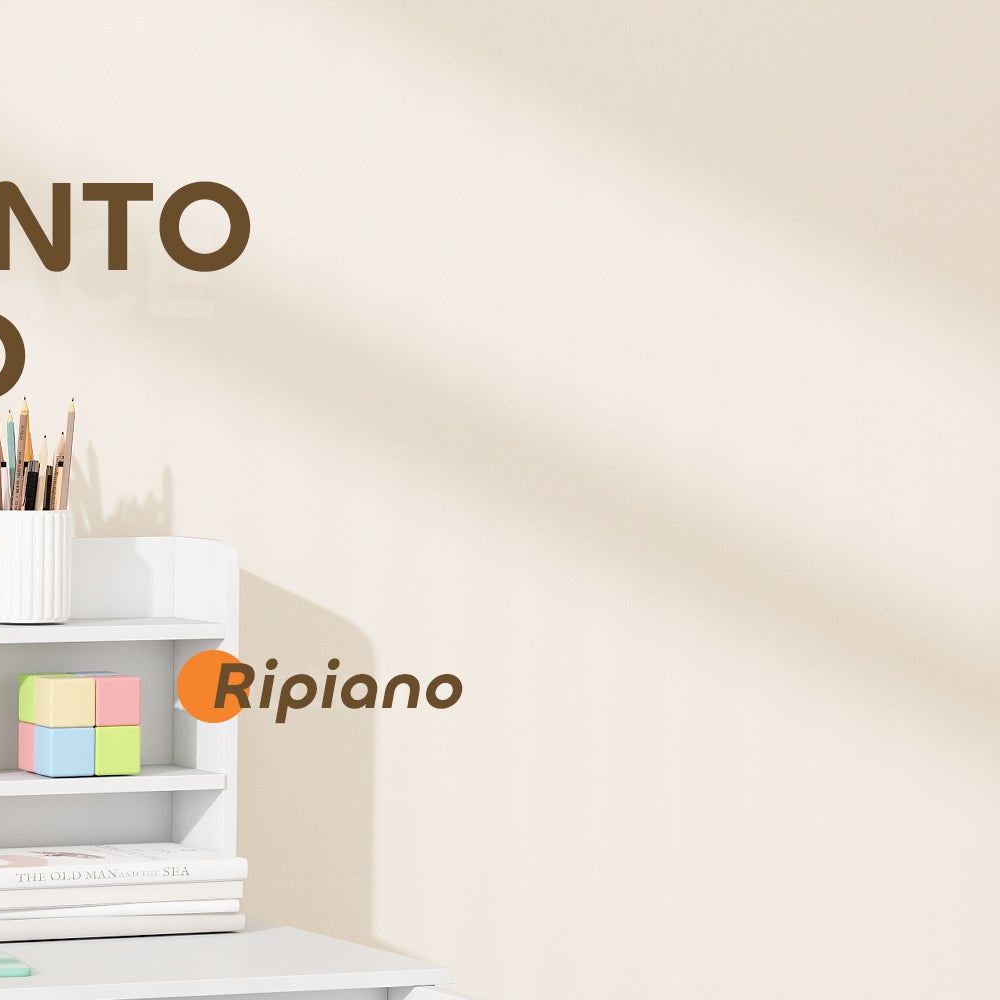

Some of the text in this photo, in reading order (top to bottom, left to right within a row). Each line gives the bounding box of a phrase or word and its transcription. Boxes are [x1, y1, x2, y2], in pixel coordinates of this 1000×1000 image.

[16, 872, 47, 883] THE
[50, 871, 82, 881] OLD
[85, 869, 119, 881] MAN
[162, 866, 191, 877] SEA
